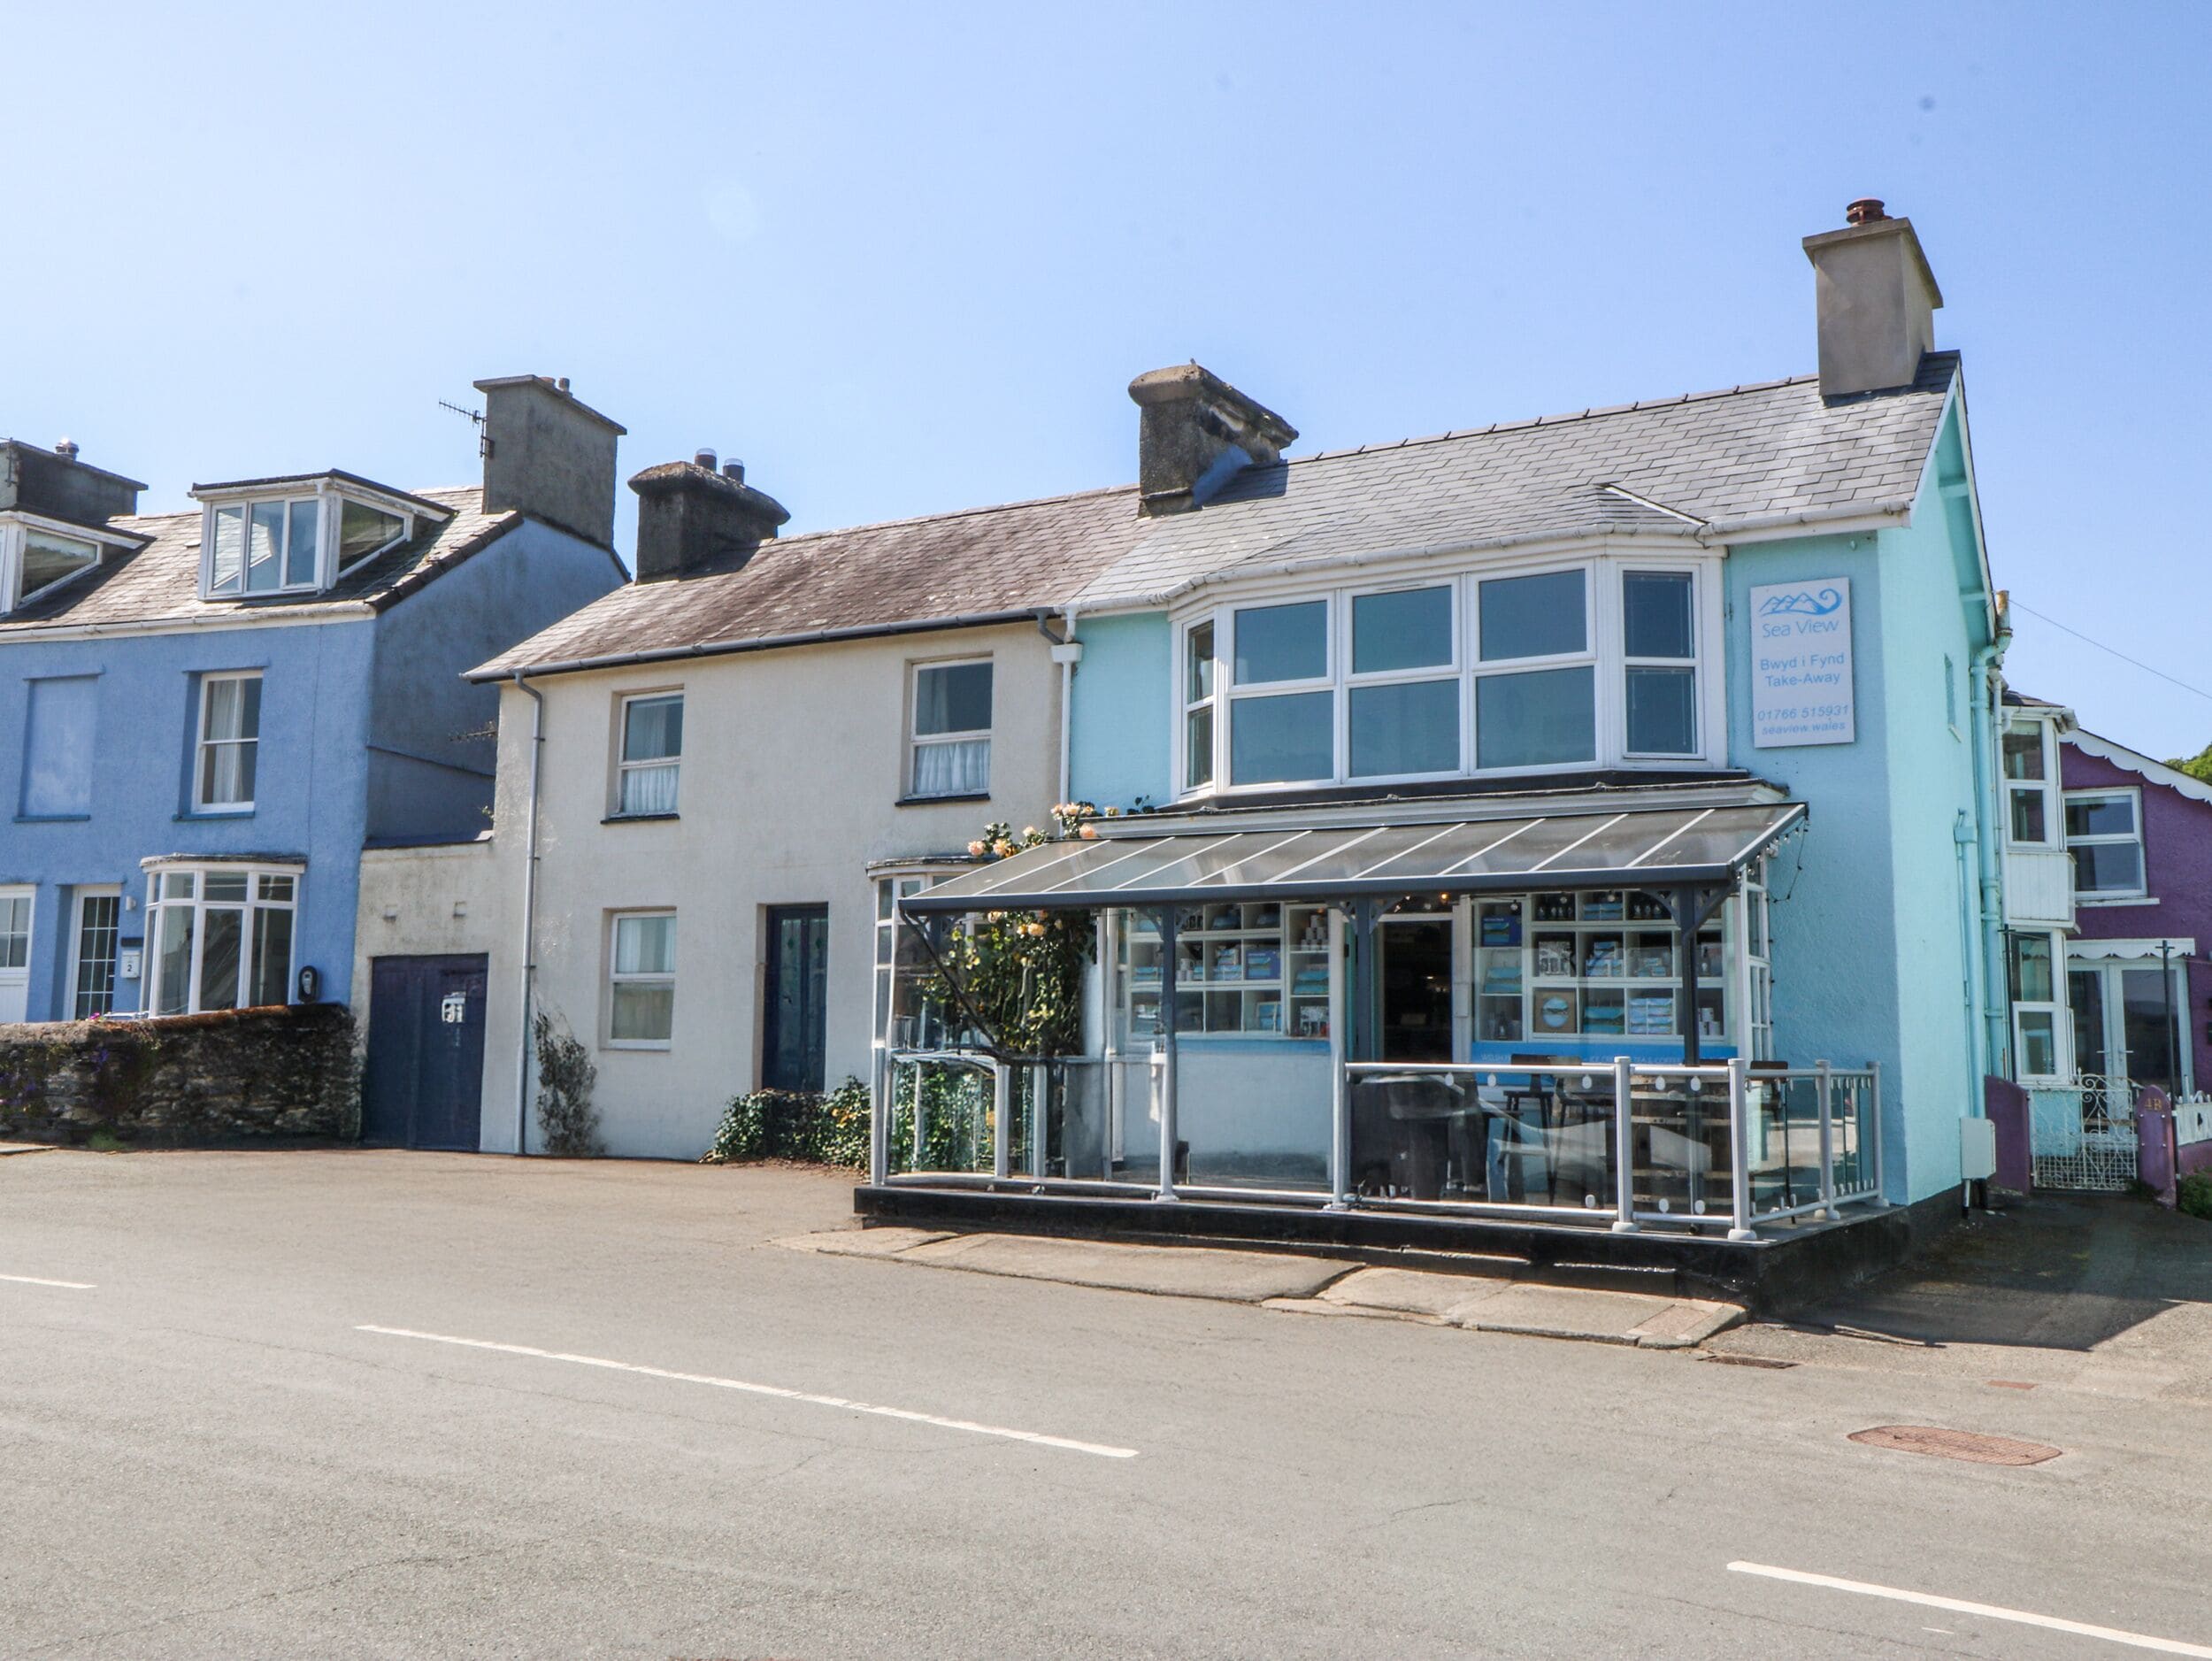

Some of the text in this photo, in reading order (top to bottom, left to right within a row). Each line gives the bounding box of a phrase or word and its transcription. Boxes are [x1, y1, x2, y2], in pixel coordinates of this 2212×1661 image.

[1763, 620, 1839, 638] Sea View
[1760, 657, 1797, 671] Bwyd
[1810, 653, 1844, 668] Fynd
[1765, 673, 1839, 687] Take-Away
[127, 964, 132, 973] 2
